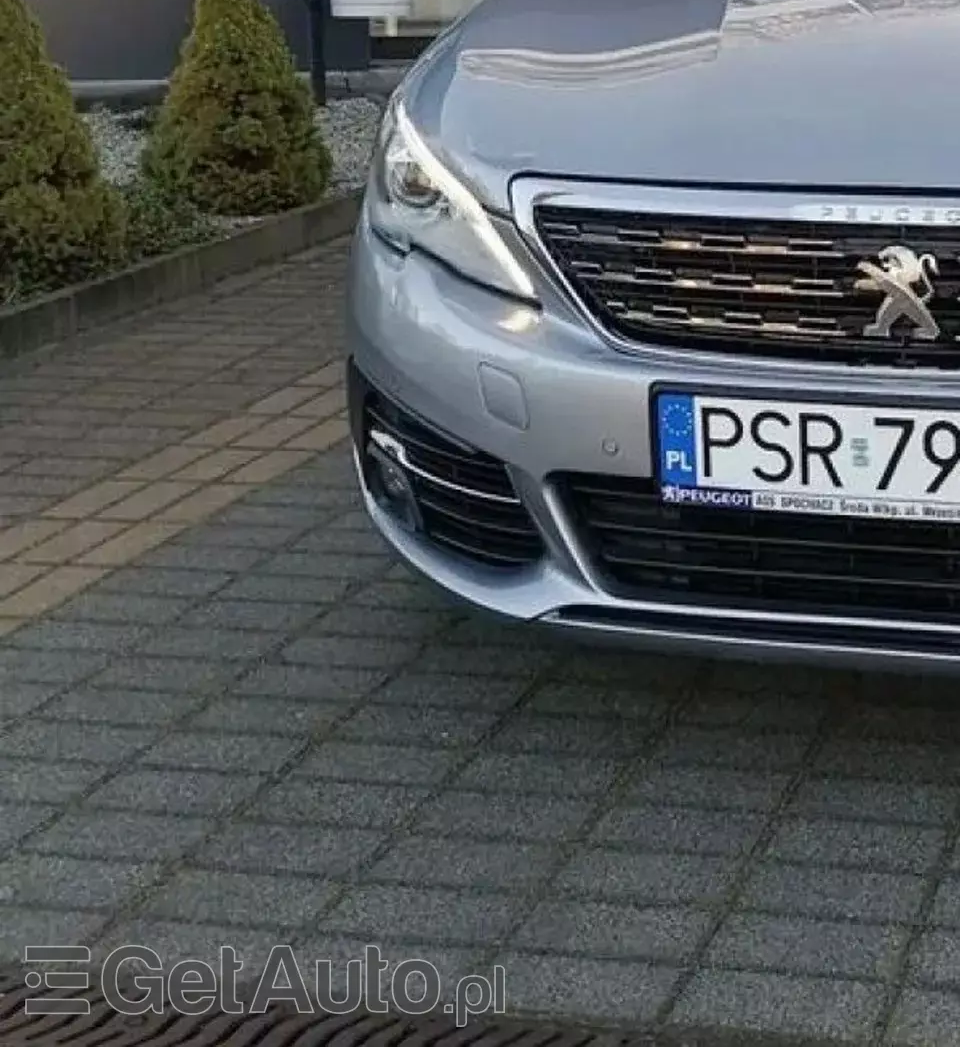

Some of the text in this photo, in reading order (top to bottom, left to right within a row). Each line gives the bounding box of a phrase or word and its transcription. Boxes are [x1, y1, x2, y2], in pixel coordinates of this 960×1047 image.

[700, 406, 844, 488] PSR
[665, 450, 693, 473] PL
[679, 488, 751, 507] PEUGEOT
